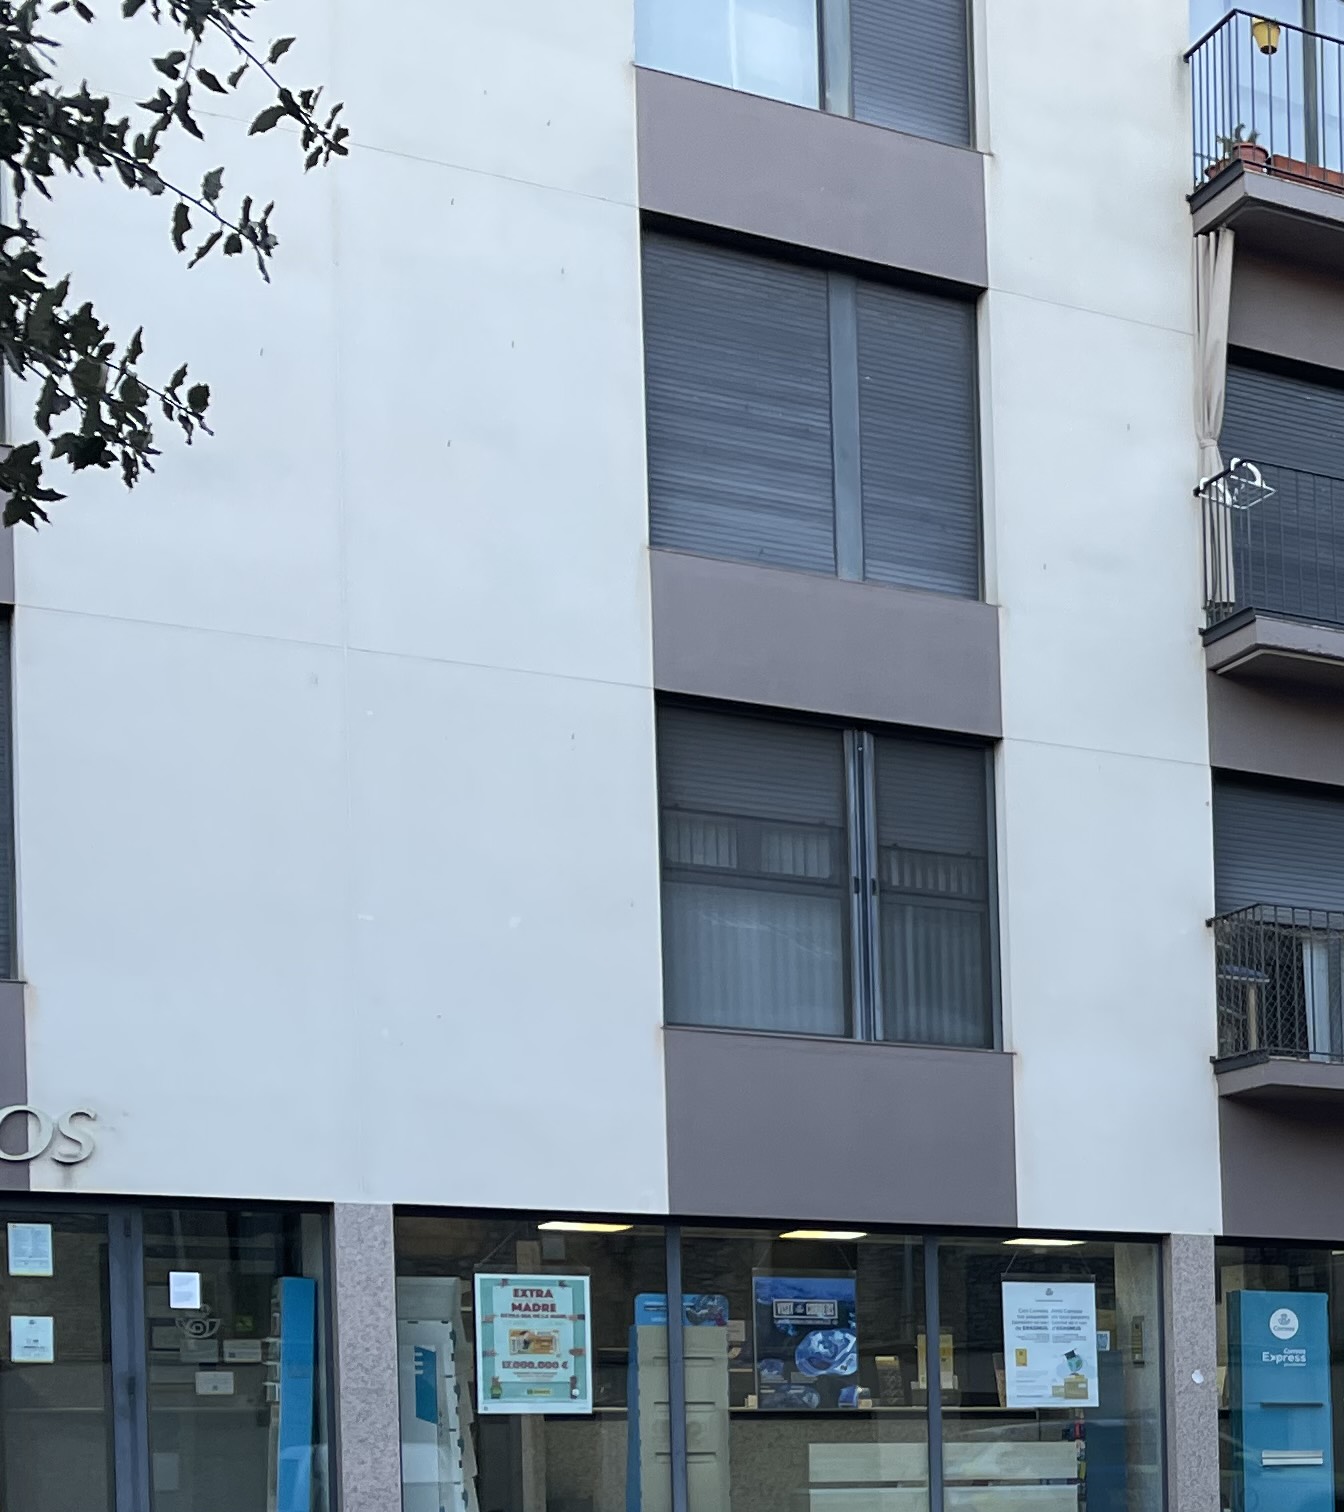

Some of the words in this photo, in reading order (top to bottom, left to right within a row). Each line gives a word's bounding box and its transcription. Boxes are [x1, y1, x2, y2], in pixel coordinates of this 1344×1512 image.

[512, 1288, 554, 1299] EXTRA
[511, 1303, 557, 1313] MADRE
[1262, 1351, 1306, 1364] Express
